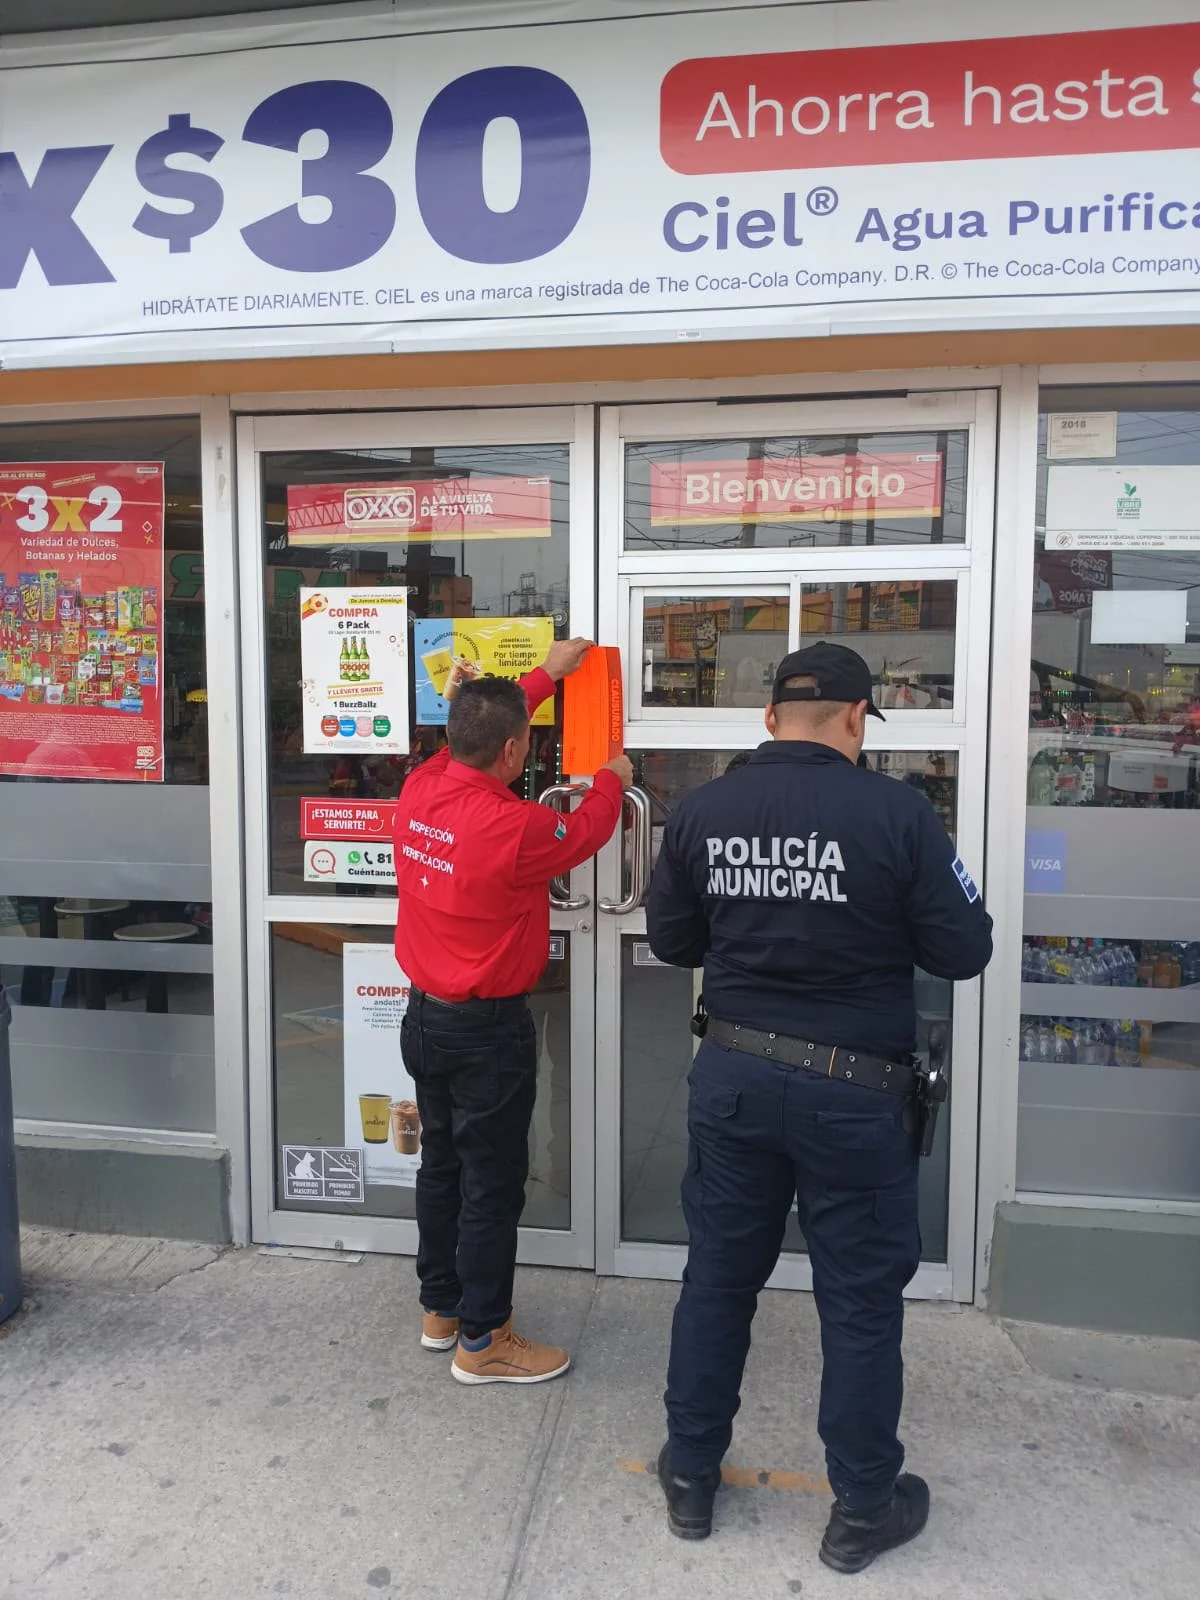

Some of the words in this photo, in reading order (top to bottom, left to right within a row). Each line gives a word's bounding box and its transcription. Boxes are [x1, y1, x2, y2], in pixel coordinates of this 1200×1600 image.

[695, 85, 934, 141] Ahorra
[964, 68, 1169, 126] hasta
[855, 207, 988, 251] Agua
[143, 293, 238, 316] HIDRÁTATE
[244, 290, 369, 310] DIARIAMENTE.
[375, 288, 415, 305] CIEL
[420, 289, 440, 302] es
[445, 287, 475, 301] una
[481, 286, 532, 300] marca
[539, 279, 623, 301] registrada
[629, 278, 650, 294] de
[656, 275, 689, 293] The
[695, 272, 789, 291] Coca-Cola
[795, 268, 887, 290] Company.
[895, 264, 934, 282] D.R.
[964, 261, 999, 278] The
[1005, 257, 1105, 277] Coca-Cola
[685, 465, 905, 505] Bienvenido
[421, 495, 429, 505] A
[432, 495, 447, 505] LA
[449, 493, 494, 504] VUELTA
[348, 495, 413, 519] OXXO
[420, 506, 437, 517] DE
[439, 505, 458, 516] TU
[459, 504, 494, 515] VIDA
[21, 537, 63, 547] Variedad
[66, 537, 78, 547] de
[82, 537, 119, 549] Dulces,
[26, 551, 65, 561] Botanas
[68, 554, 74, 563] y
[77, 551, 117, 561] Helados
[328, 608, 378, 618] COMPRA
[338, 621, 344, 629] 6
[346, 620, 370, 629] Pack
[508, 651, 537, 661] tiempo
[499, 658, 532, 667] limitado
[611, 679, 620, 742] CLAUSURADO
[311, 808, 352, 820] ¡ESTAMOS
[356, 810, 378, 820] PARA
[324, 820, 366, 830] SERVIRTE!
[706, 832, 845, 871] POLICÍA
[377, 853, 392, 864] 81
[1030, 859, 1061, 871] VISA
[348, 867, 396, 877] Cuéntanos
[707, 868, 847, 902] MUNICIPAL
[357, 985, 410, 998] COMPR
